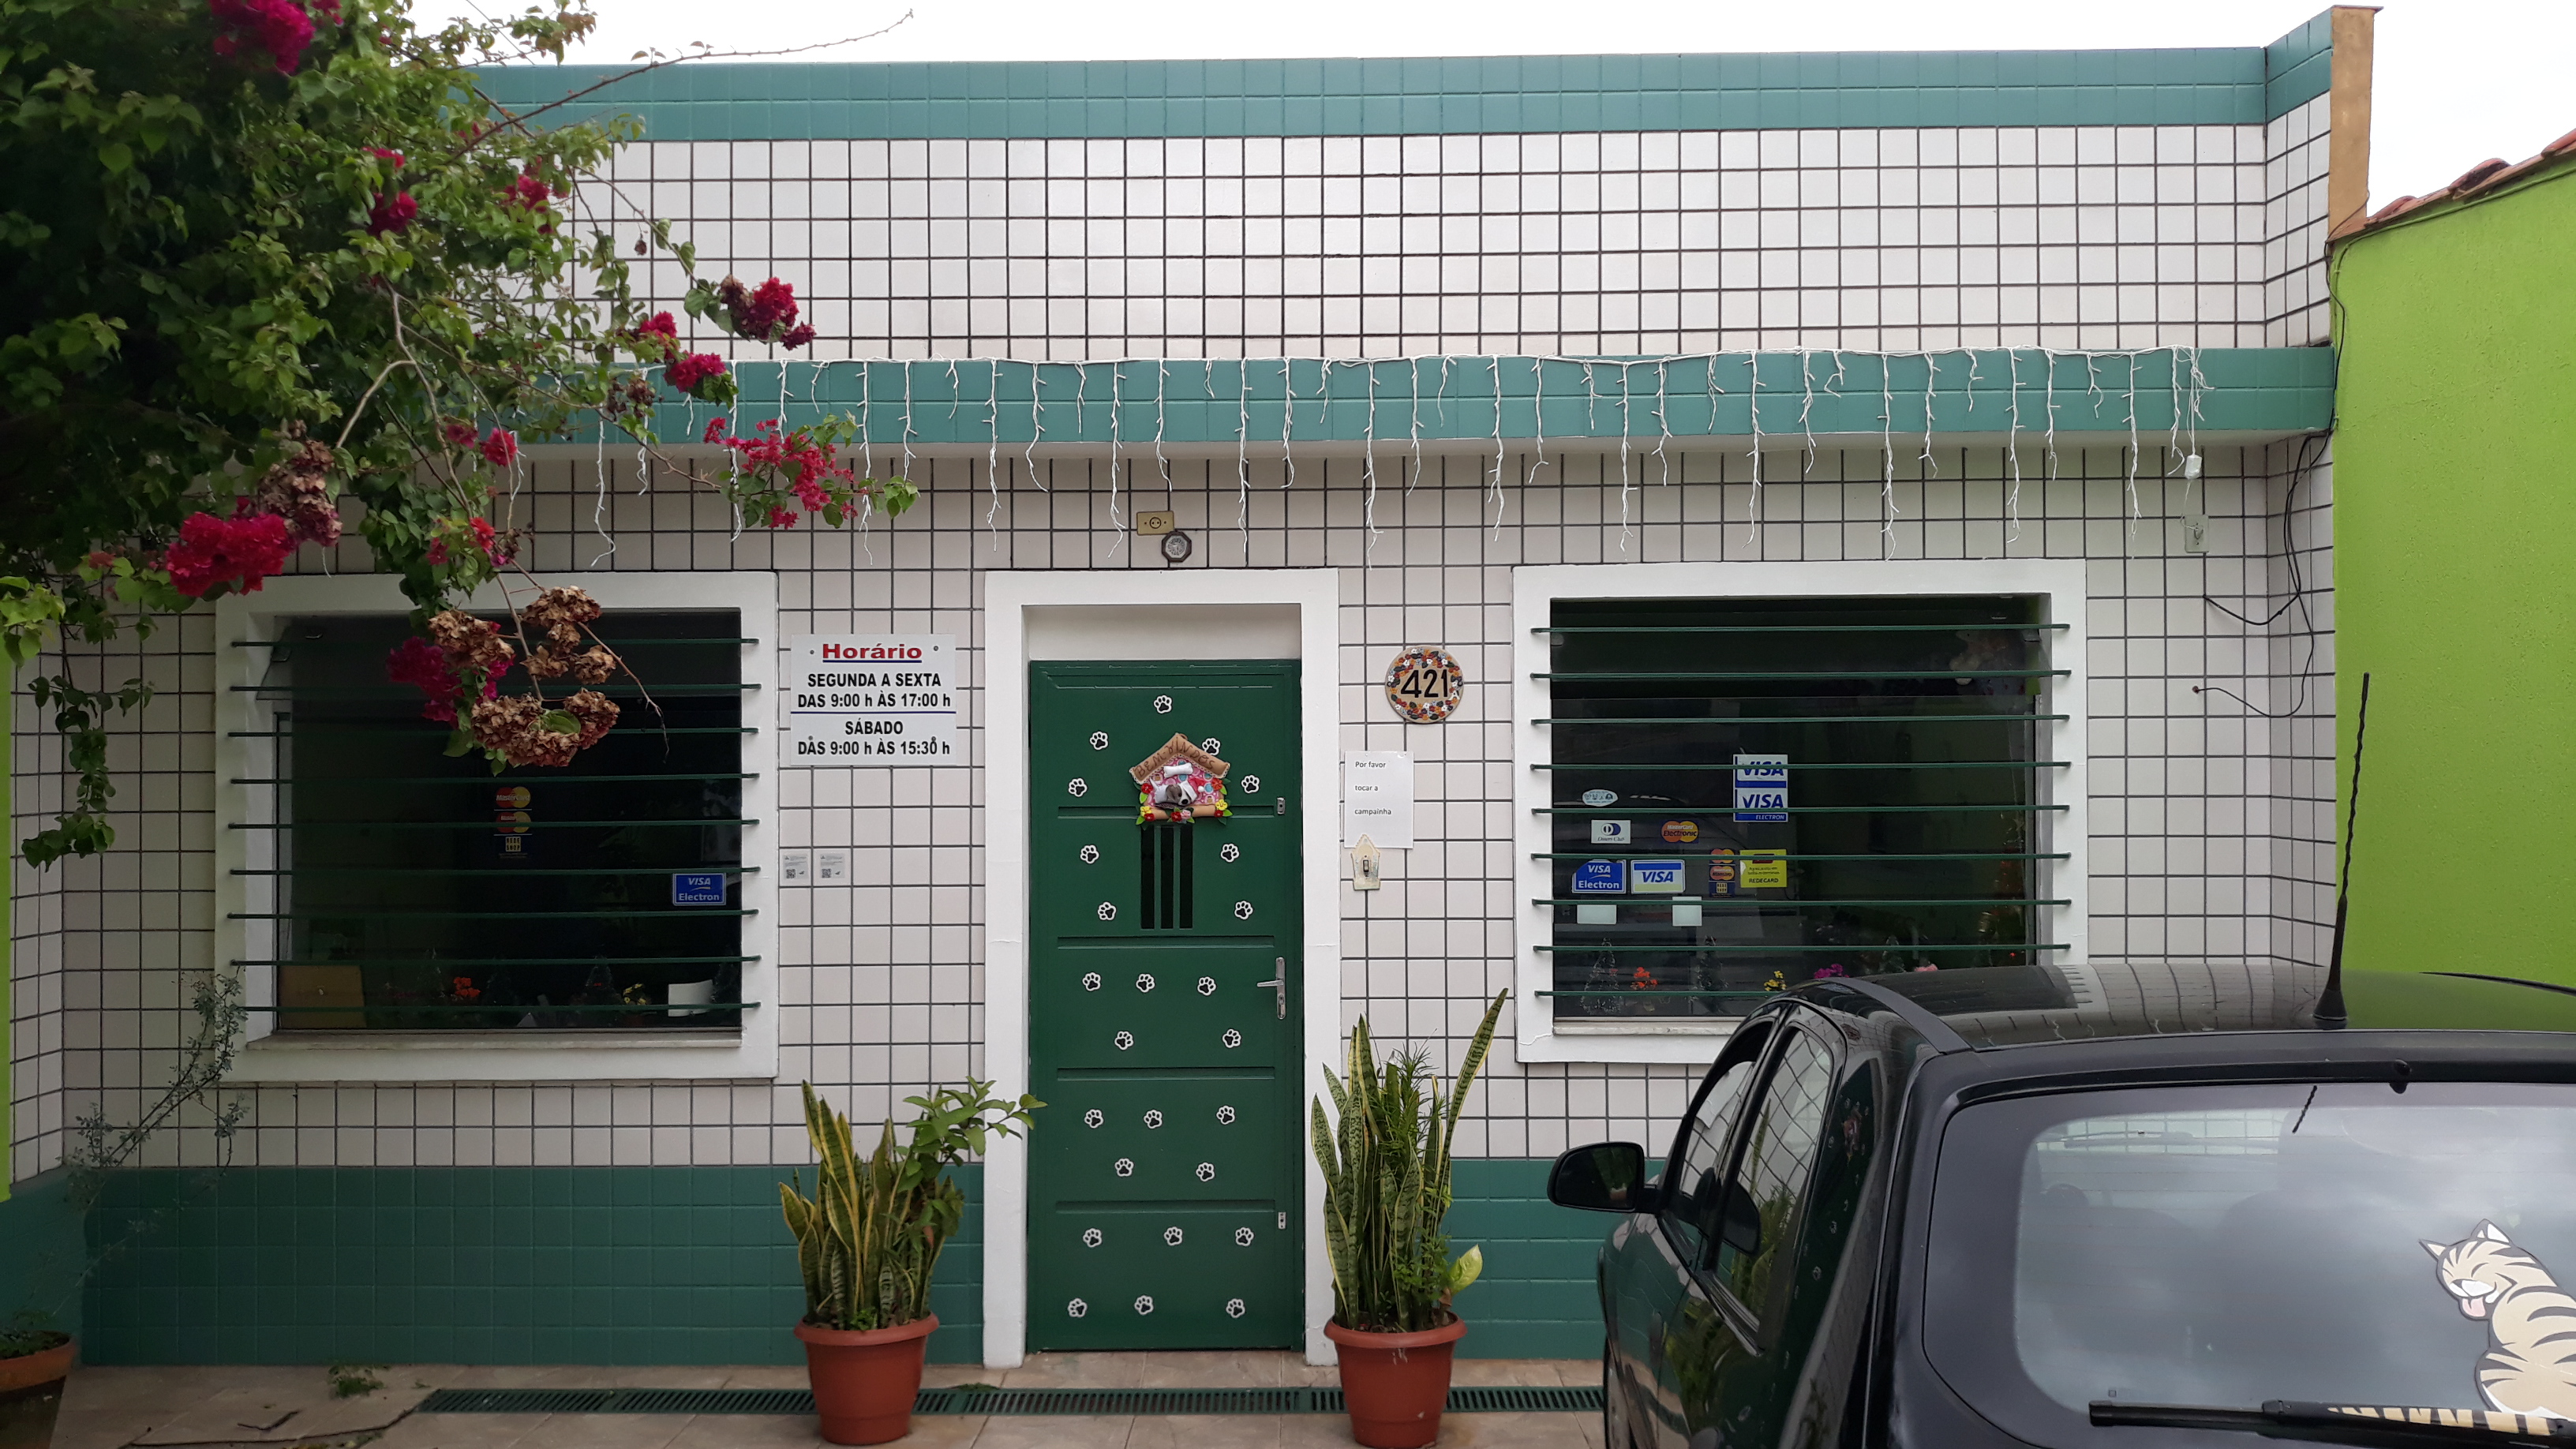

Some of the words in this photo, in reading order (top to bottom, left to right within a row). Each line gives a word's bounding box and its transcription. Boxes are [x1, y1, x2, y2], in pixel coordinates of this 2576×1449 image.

[822, 643, 922, 659] Horário
[807, 673, 877, 687] SEGUNDA
[882, 673, 891, 687] A
[895, 673, 942, 687] SEXTA
[1401, 669, 1447, 698] 421
[798, 694, 826, 707] DAS
[830, 693, 860, 707] 9:00
[865, 693, 873, 706] h
[877, 691, 896, 706] ÀS
[901, 693, 938, 706] 17:00
[943, 693, 951, 706] h
[844, 717, 904, 735] SÁBADO
[798, 741, 826, 754] DAS
[830, 741, 859, 754] 9:00
[864, 741, 872, 754] h
[876, 738, 895, 754] ÀS
[900, 741, 938, 754] 15:30
[942, 741, 950, 754] h
[1743, 761, 1784, 776] VISA
[1742, 794, 1784, 808] VISA
[1642, 871, 1673, 882] VISA
[1578, 880, 1619, 889] Electron
